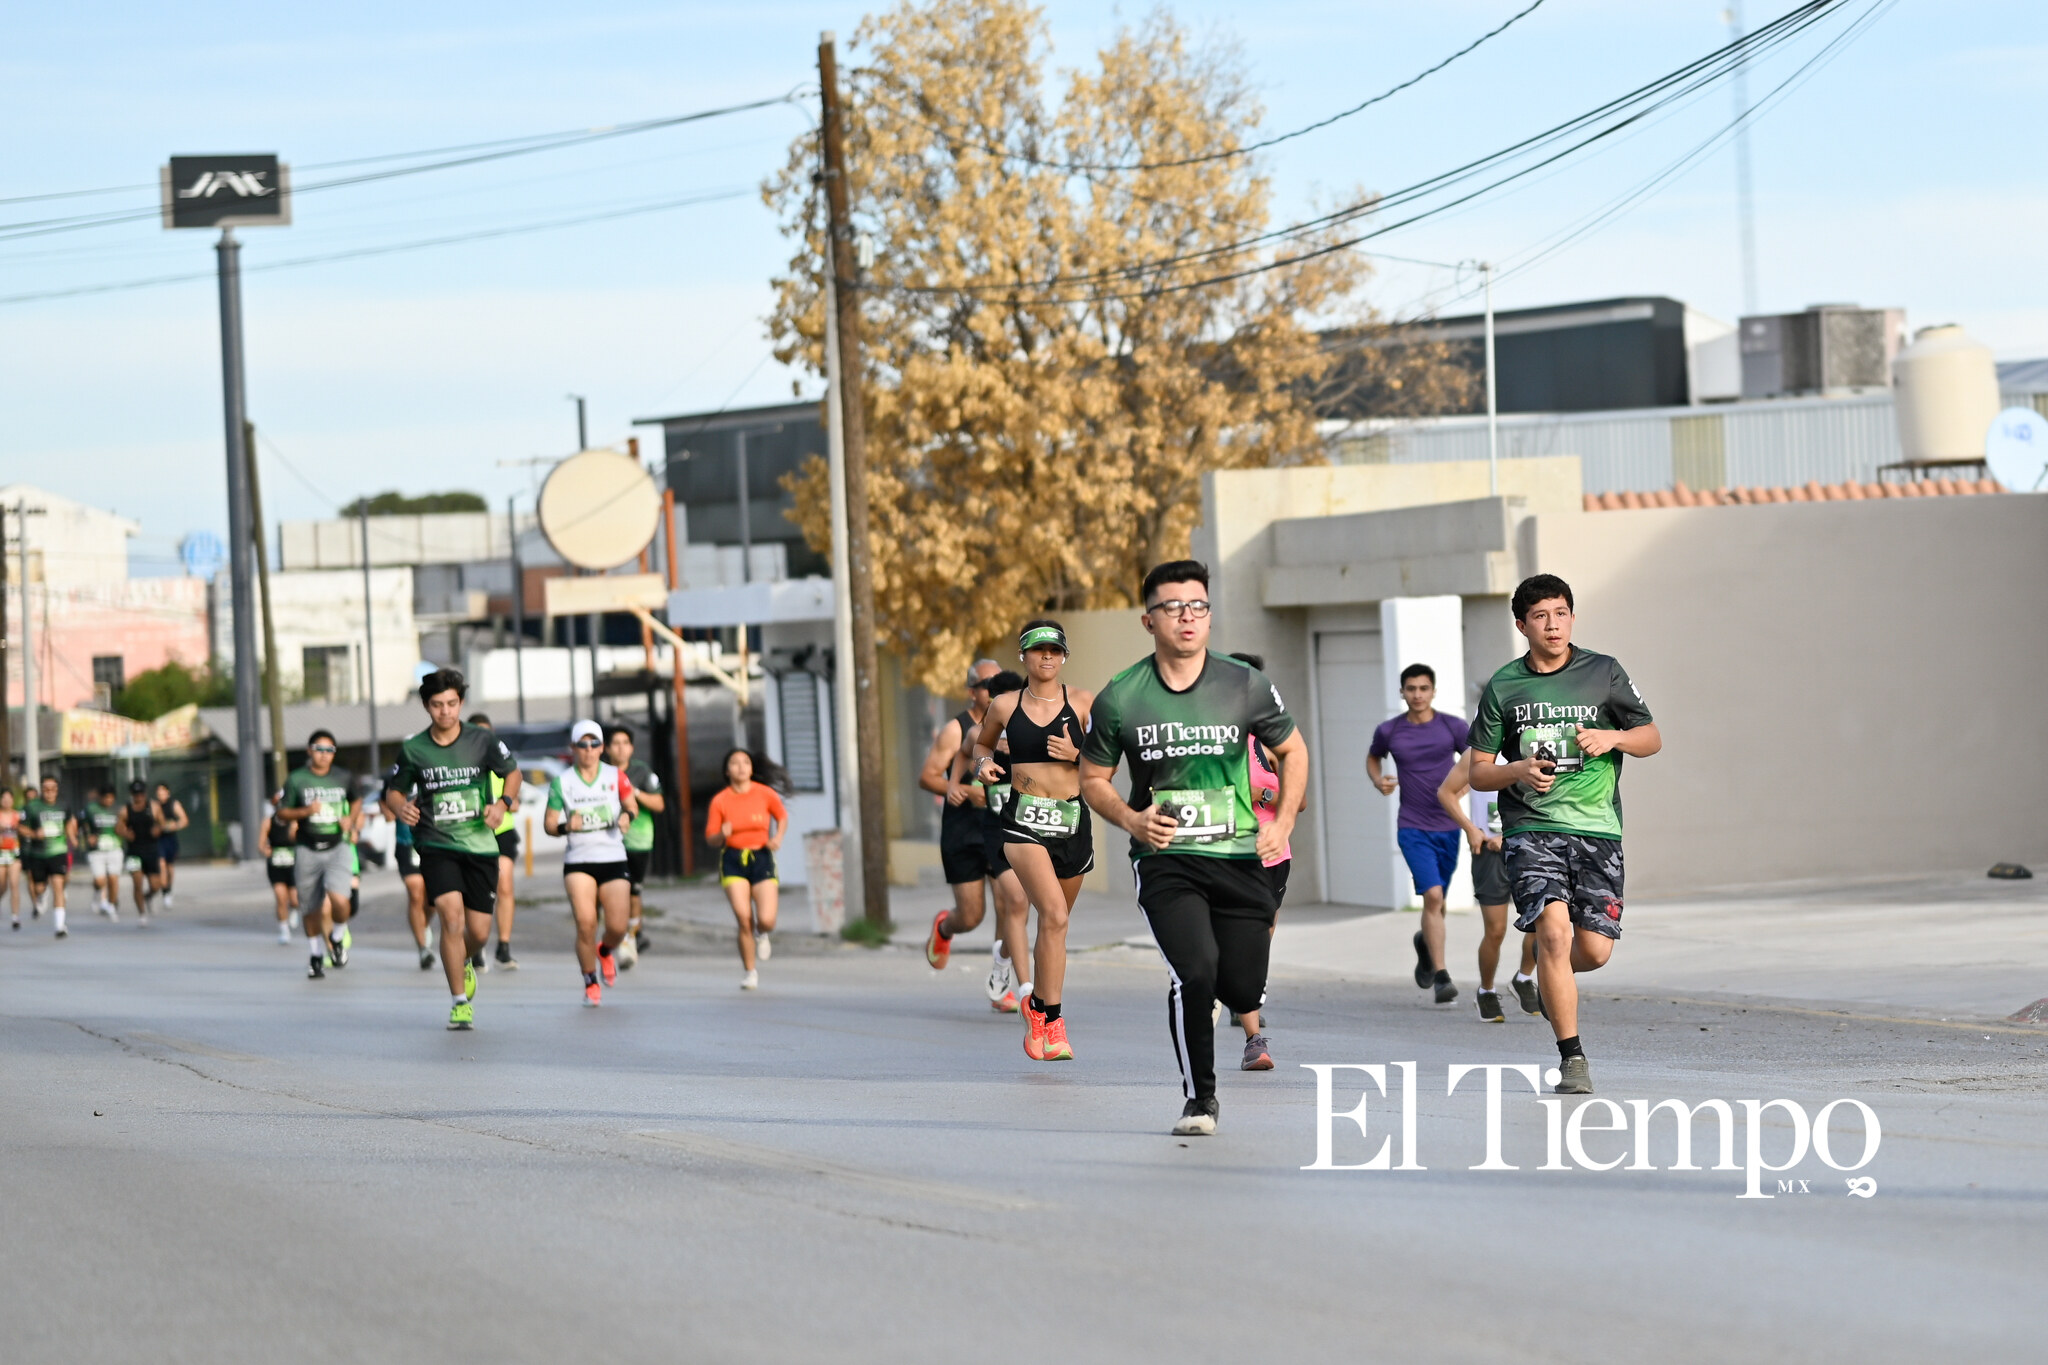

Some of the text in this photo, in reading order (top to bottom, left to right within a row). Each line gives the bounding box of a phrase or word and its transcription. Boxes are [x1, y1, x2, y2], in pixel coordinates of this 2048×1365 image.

[1514, 702, 1598, 722] El Tiempo
[1136, 722, 1240, 747] El Tiempo
[1140, 742, 1225, 761] de todos
[438, 799, 466, 816] 241
[1023, 805, 1063, 826] 558
